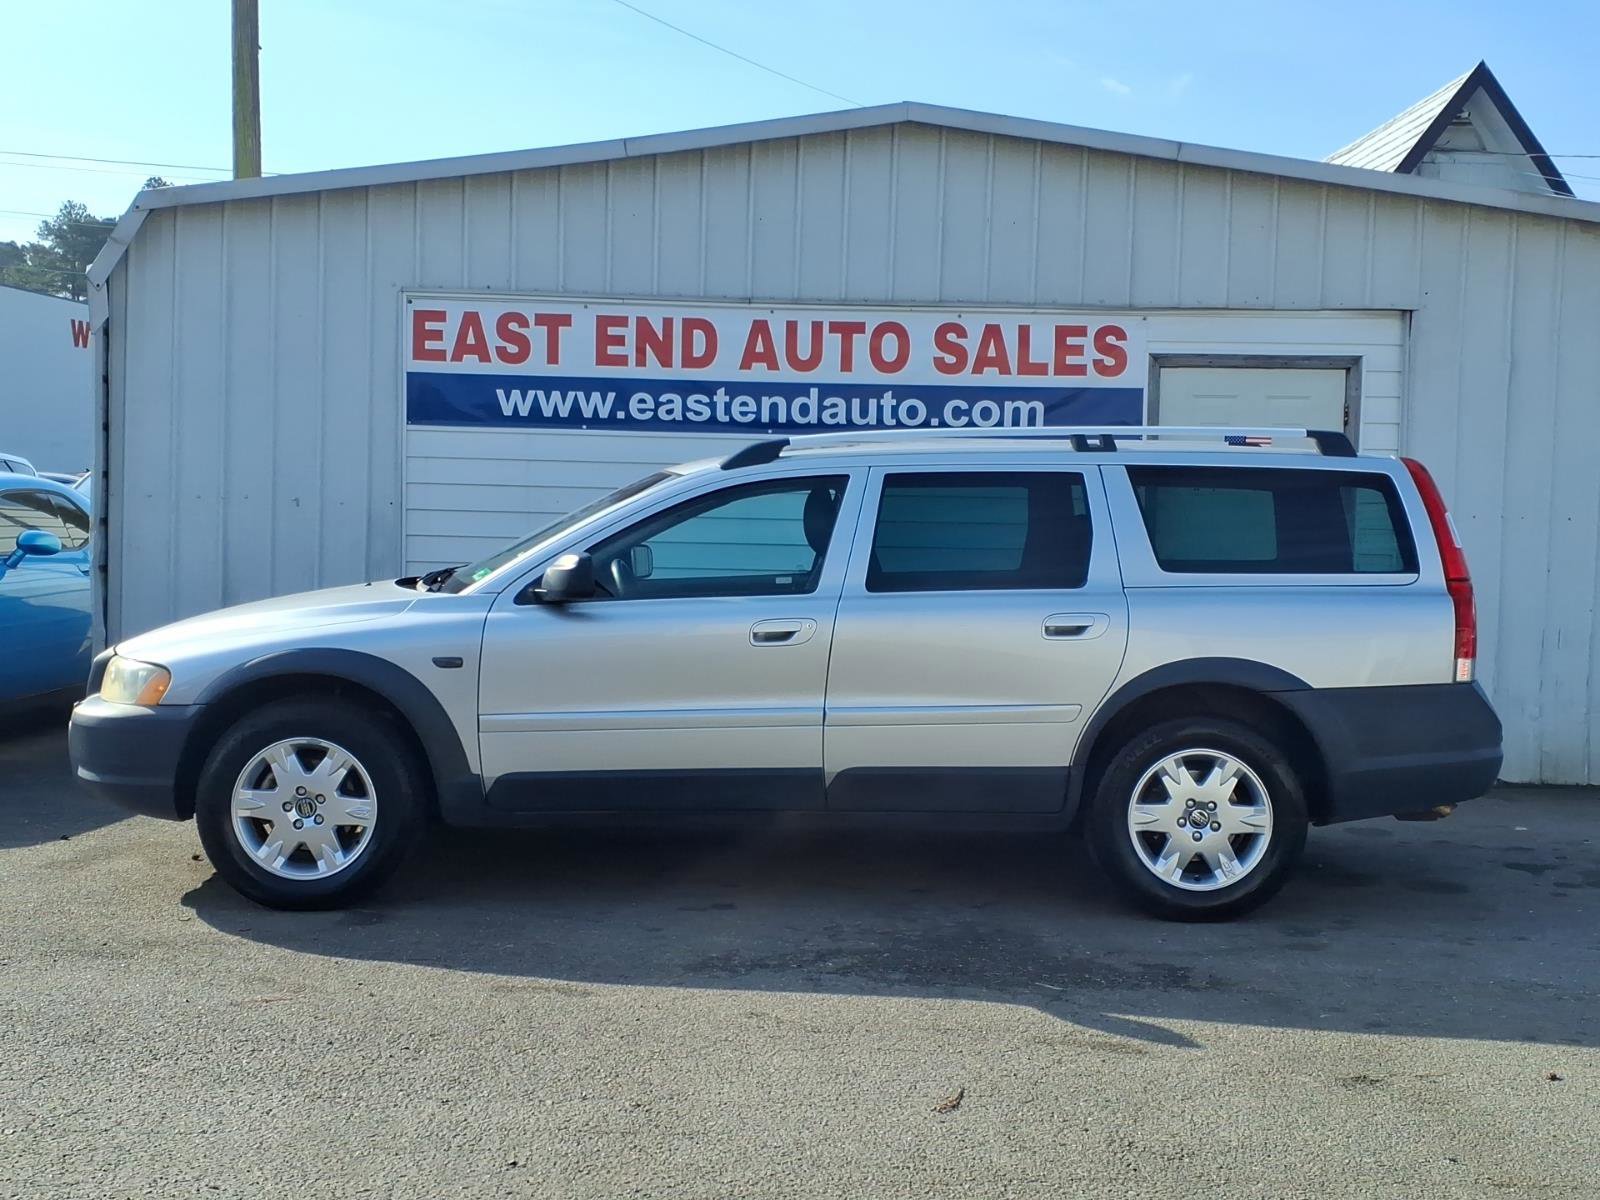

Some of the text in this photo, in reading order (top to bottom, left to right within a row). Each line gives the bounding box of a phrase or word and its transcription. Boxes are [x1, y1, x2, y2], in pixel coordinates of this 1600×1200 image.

[412, 309, 1128, 377] EAST END AUTO SALES
[495, 387, 1045, 427] www.eastendauto.com
